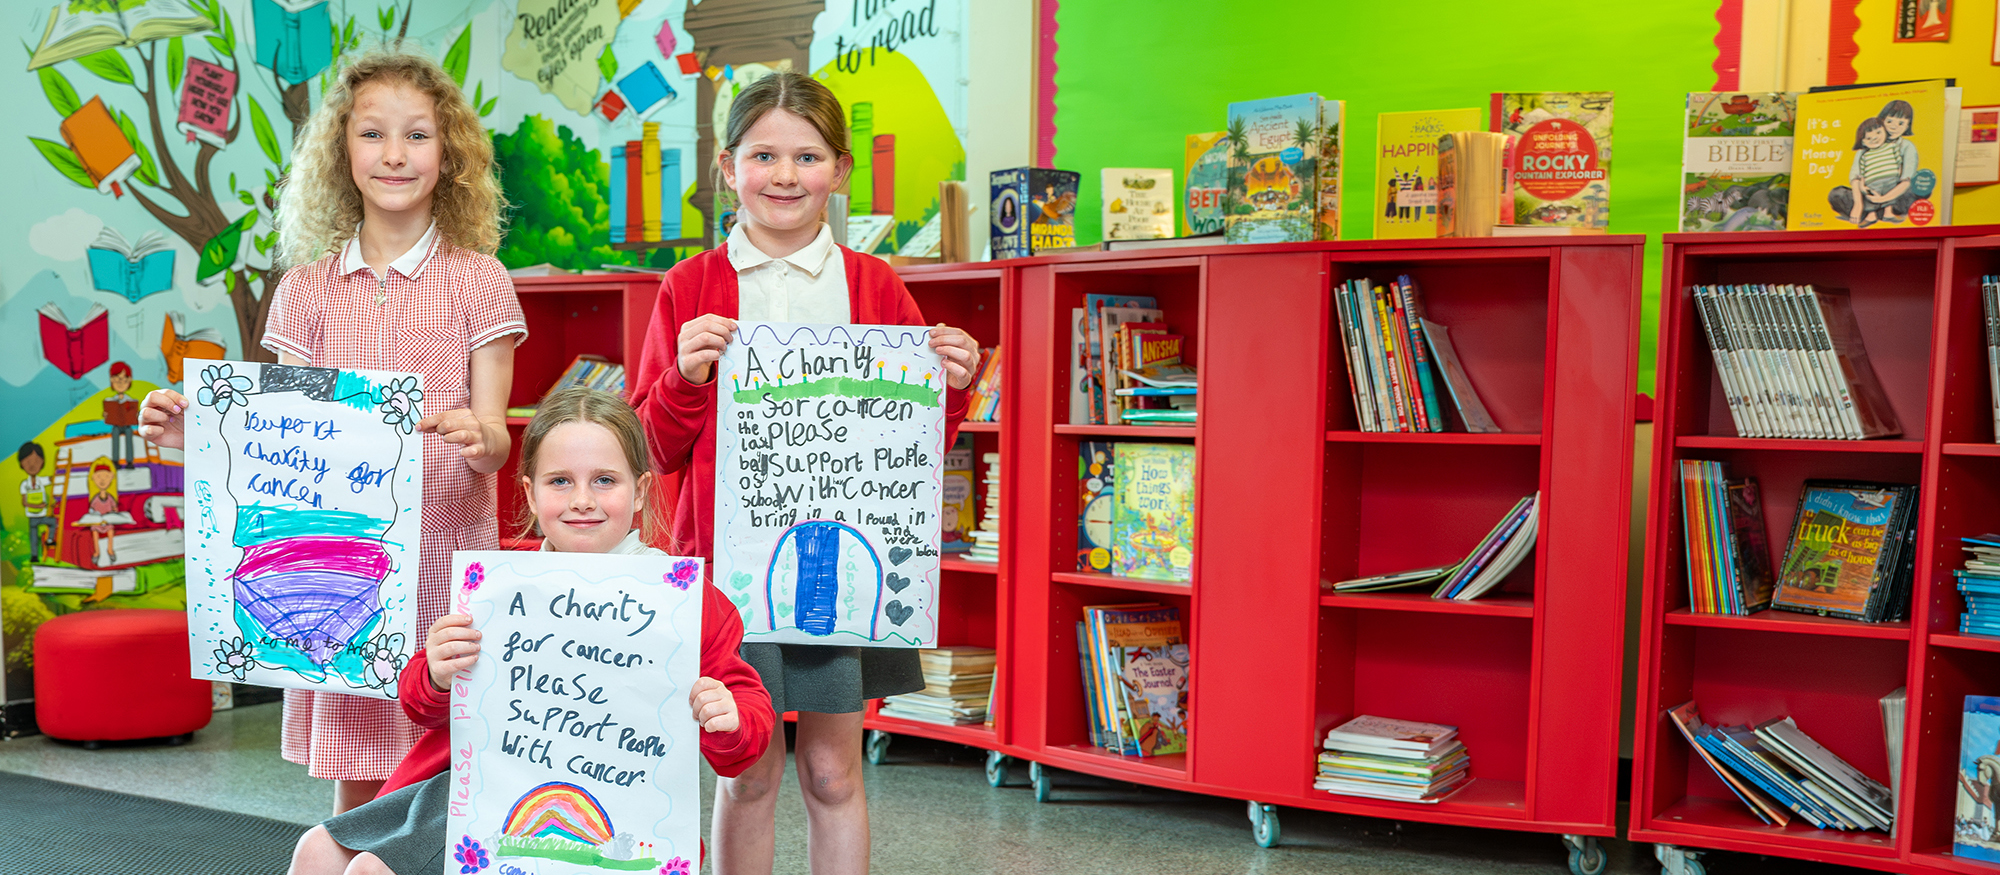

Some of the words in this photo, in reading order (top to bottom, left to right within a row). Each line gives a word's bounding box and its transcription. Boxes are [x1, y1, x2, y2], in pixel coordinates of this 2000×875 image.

[834, 36, 862, 74] to
[871, 0, 939, 66] read
[1248, 119, 1289, 135] Ancient
[1807, 118, 1828, 130] It's
[1832, 119, 1842, 128] a
[1259, 131, 1292, 150] Egypt
[1382, 142, 1439, 158] HAPPIN
[1708, 145, 1784, 162] BIBLE
[1802, 149, 1844, 162] Money
[1523, 155, 1589, 171] ROCKY
[1808, 163, 1835, 179] Day
[1514, 171, 1553, 180] OUNTAIN
[1555, 170, 1603, 179] EXPLORER
[1031, 223, 1074, 236] MIRANDA
[1142, 339, 1179, 363] ANISHA
[744, 346, 769, 387] A
[780, 341, 875, 379] Charity
[1388, 357, 1399, 384] ROBERT
[1393, 384, 1405, 416] WINSTON
[737, 410, 754, 420] on
[738, 421, 760, 435] the
[1141, 464, 1168, 481] How
[1136, 482, 1172, 496] things
[1139, 496, 1172, 511] work
[750, 508, 797, 527] bring
[806, 504, 821, 520] in
[835, 510, 847, 521] a
[909, 507, 925, 526] in
[1838, 505, 1863, 523] know
[882, 525, 911, 537] and
[1798, 518, 1851, 544] truck
[1846, 553, 1876, 565] house
[508, 591, 527, 616] A
[503, 630, 555, 662] for
[1132, 667, 1149, 677] The
[1150, 666, 1175, 677] Easter
[509, 664, 609, 705] Please
[1143, 677, 1174, 688] Journal
[453, 667, 473, 721] Hel
[501, 730, 553, 769] With
[450, 740, 473, 818] Please
